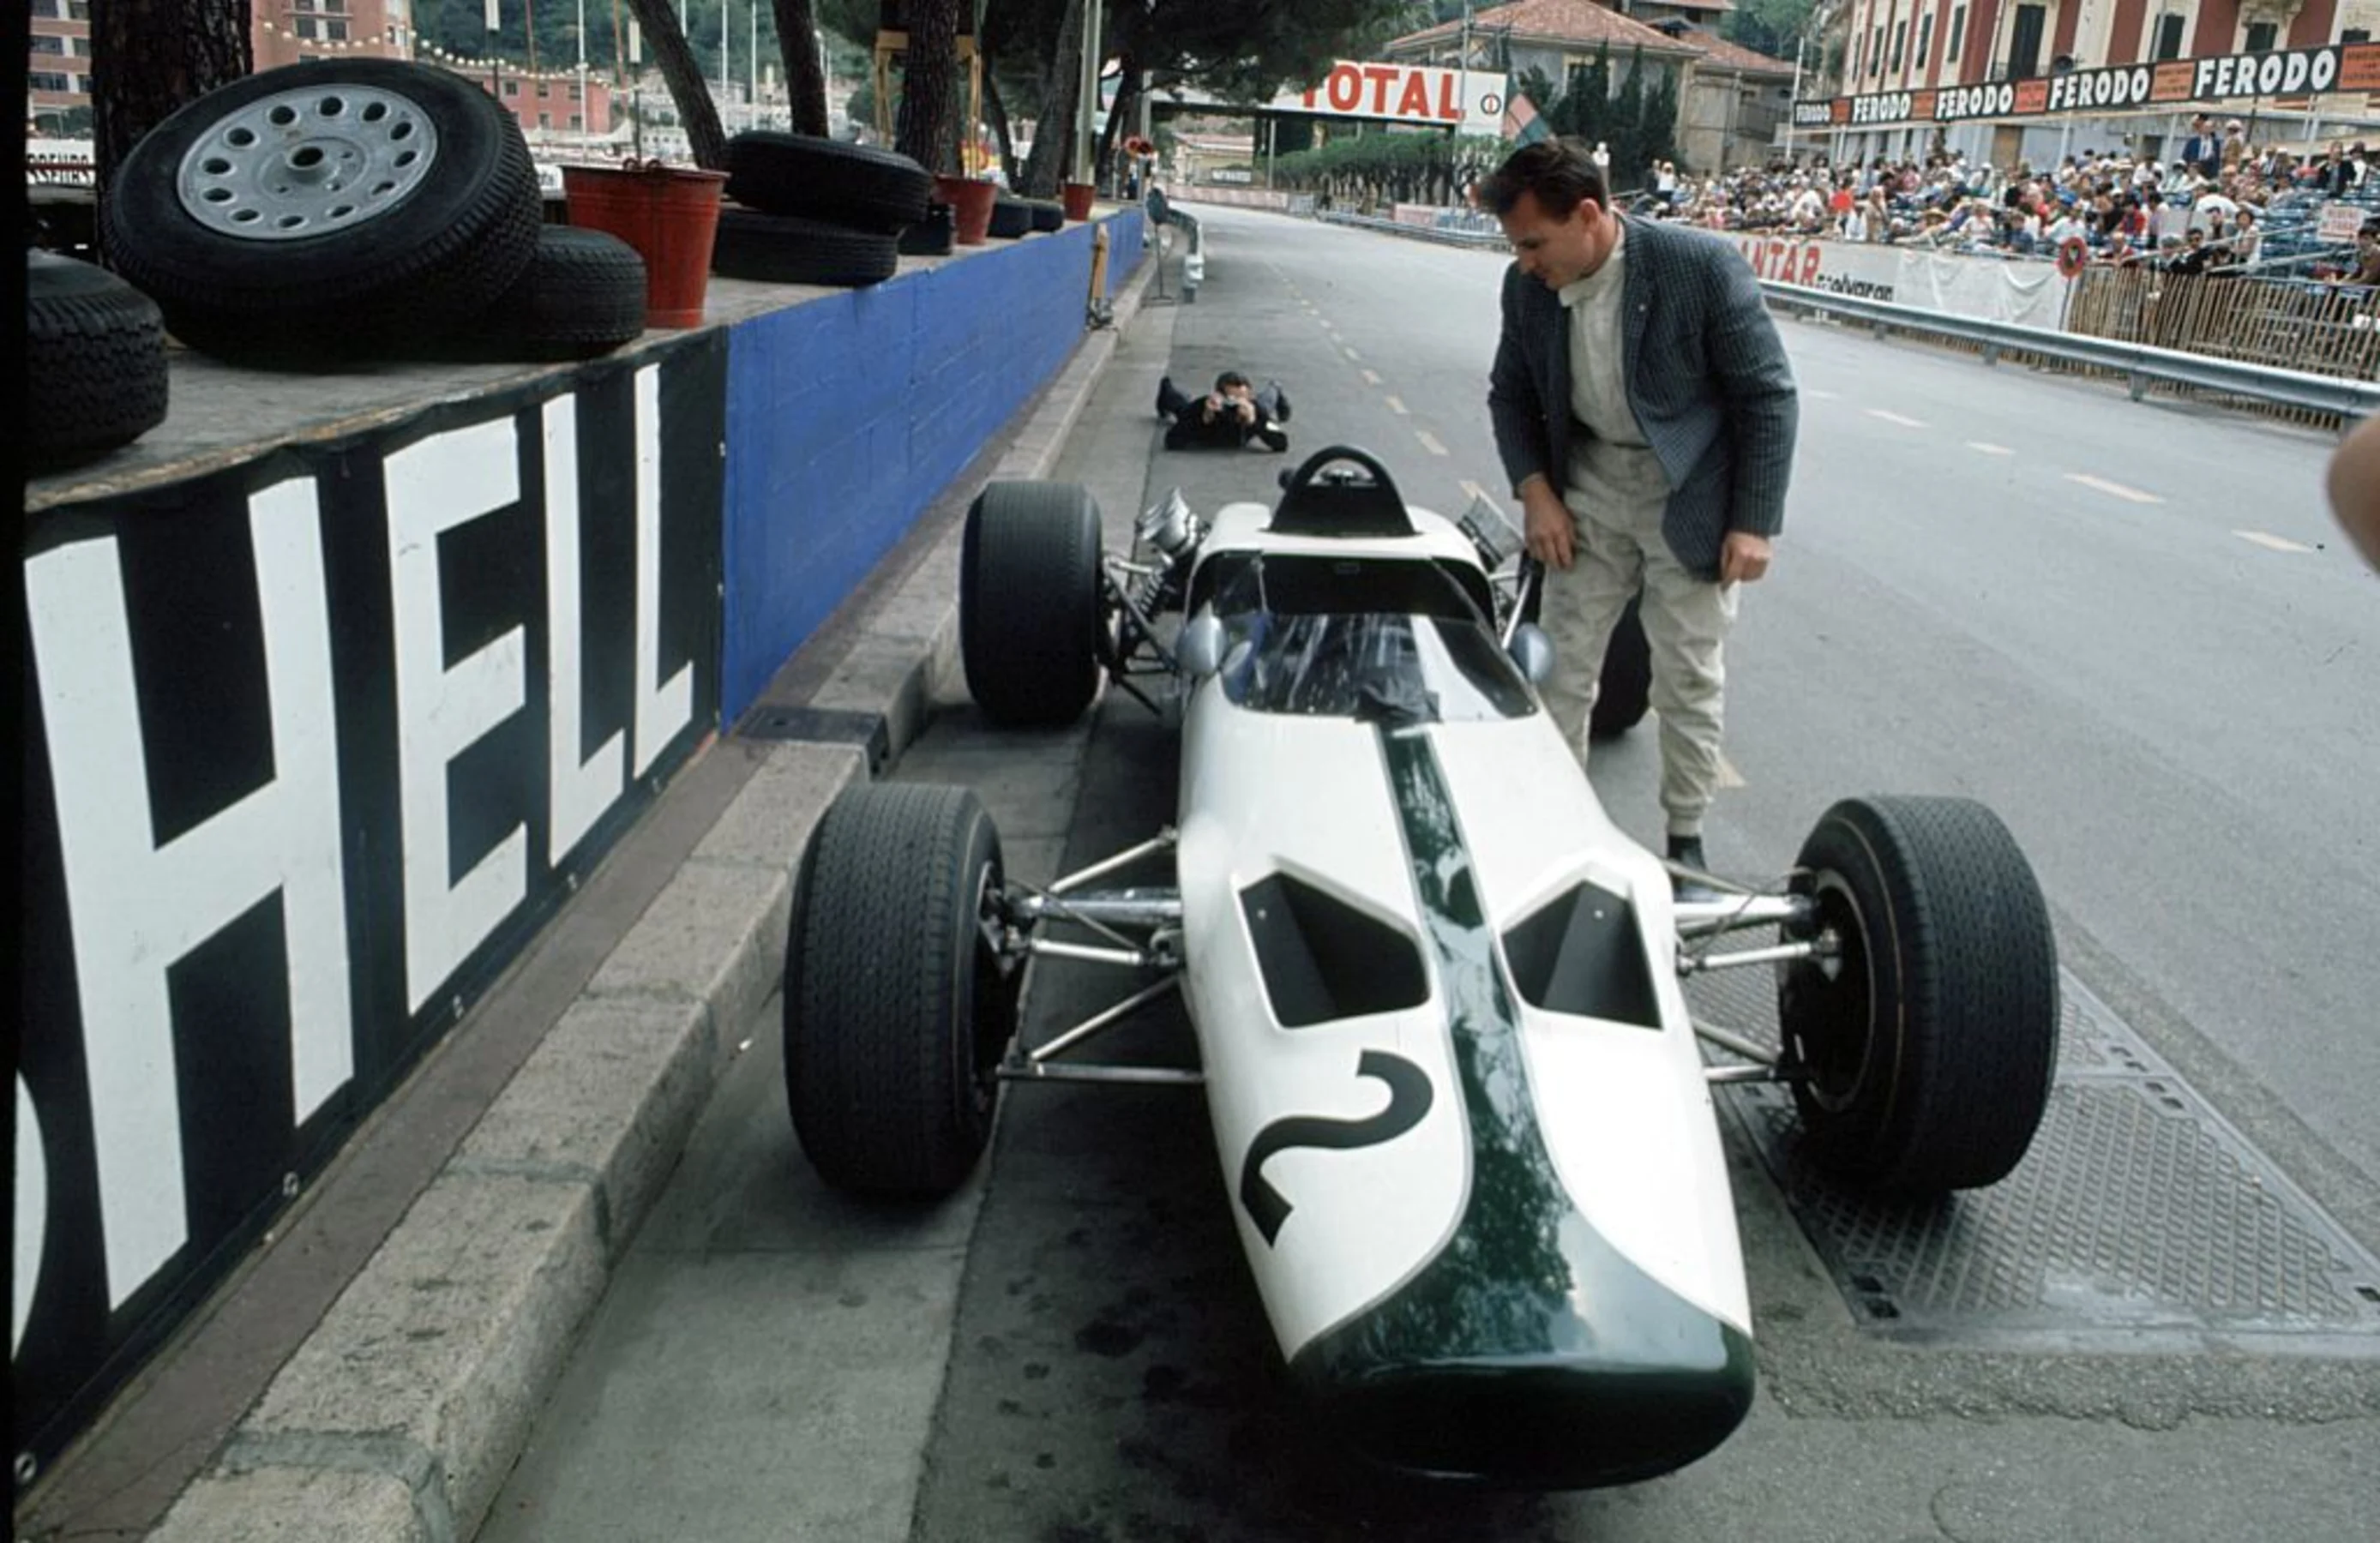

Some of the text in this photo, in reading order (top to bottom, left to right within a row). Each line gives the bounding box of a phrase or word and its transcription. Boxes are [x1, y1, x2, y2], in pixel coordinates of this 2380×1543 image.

[2048, 68, 2150, 111] FERODO
[2194, 49, 2336, 98] FERODO
[1852, 93, 1911, 123] FERODO
[1935, 83, 2013, 120] FERODO
[1741, 240, 1821, 287] NTAR
[12, 363, 693, 1363] HELL
[1241, 1048, 1434, 1250] 2
